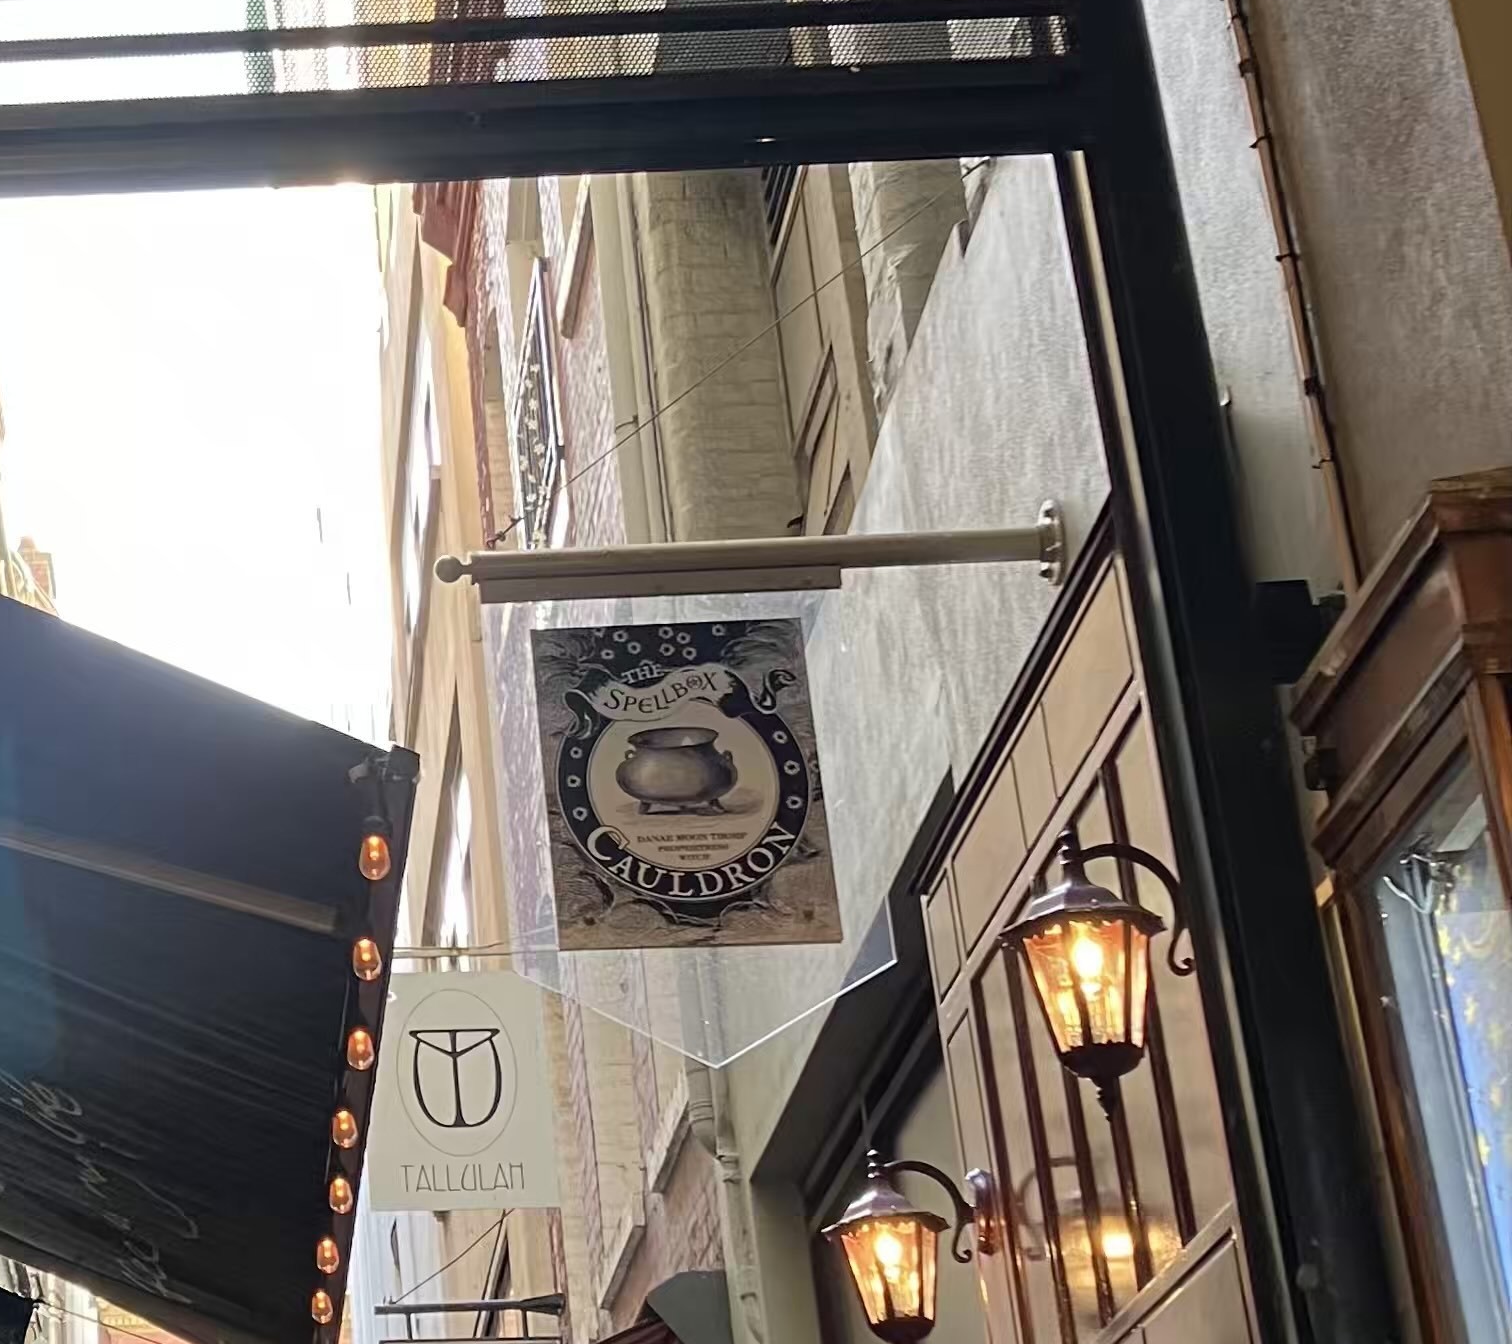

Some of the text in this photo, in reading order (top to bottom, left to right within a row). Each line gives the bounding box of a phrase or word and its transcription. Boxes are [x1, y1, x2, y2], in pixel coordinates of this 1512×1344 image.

[622, 659, 666, 685] THE
[587, 821, 796, 897] CAULDRON
[400, 1162, 525, 1193] TALLULAH
